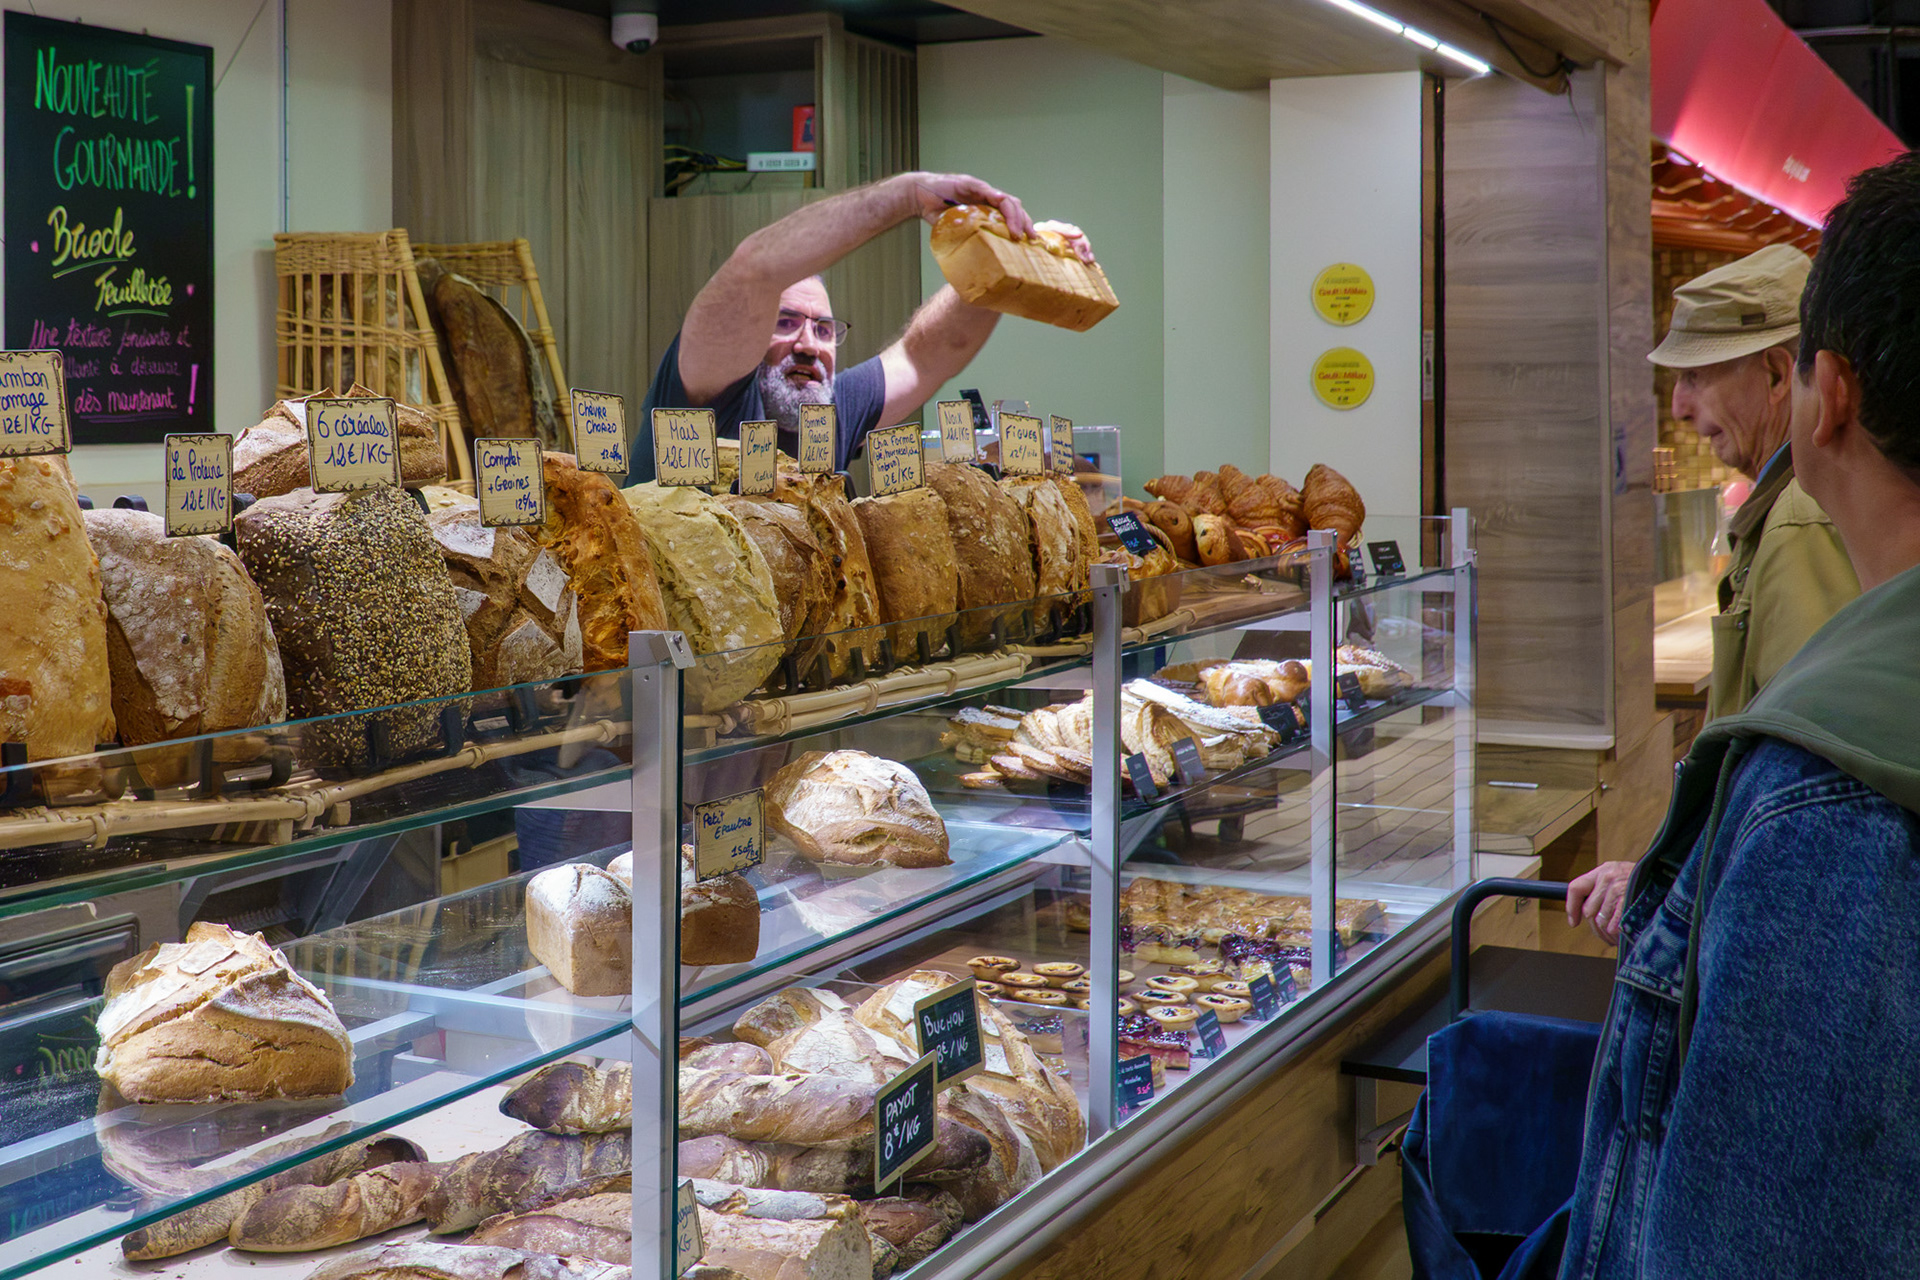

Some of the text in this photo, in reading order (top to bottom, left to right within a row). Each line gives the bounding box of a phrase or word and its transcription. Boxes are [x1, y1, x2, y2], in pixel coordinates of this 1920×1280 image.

[34, 46, 160, 125] NOUVEAUTÉ
[53, 125, 182, 198] GOURMANDE
[0, 392, 49, 417] omage
[74, 387, 102, 414] dès
[3, 413, 54, 435] 12€/KG
[317, 410, 390, 439] 6 céréales
[668, 418, 700, 441] Maïs
[324, 441, 392, 467] 12€/KG
[661, 445, 711, 469] 12€/KG
[885, 1082, 919, 1128] PAYOT
